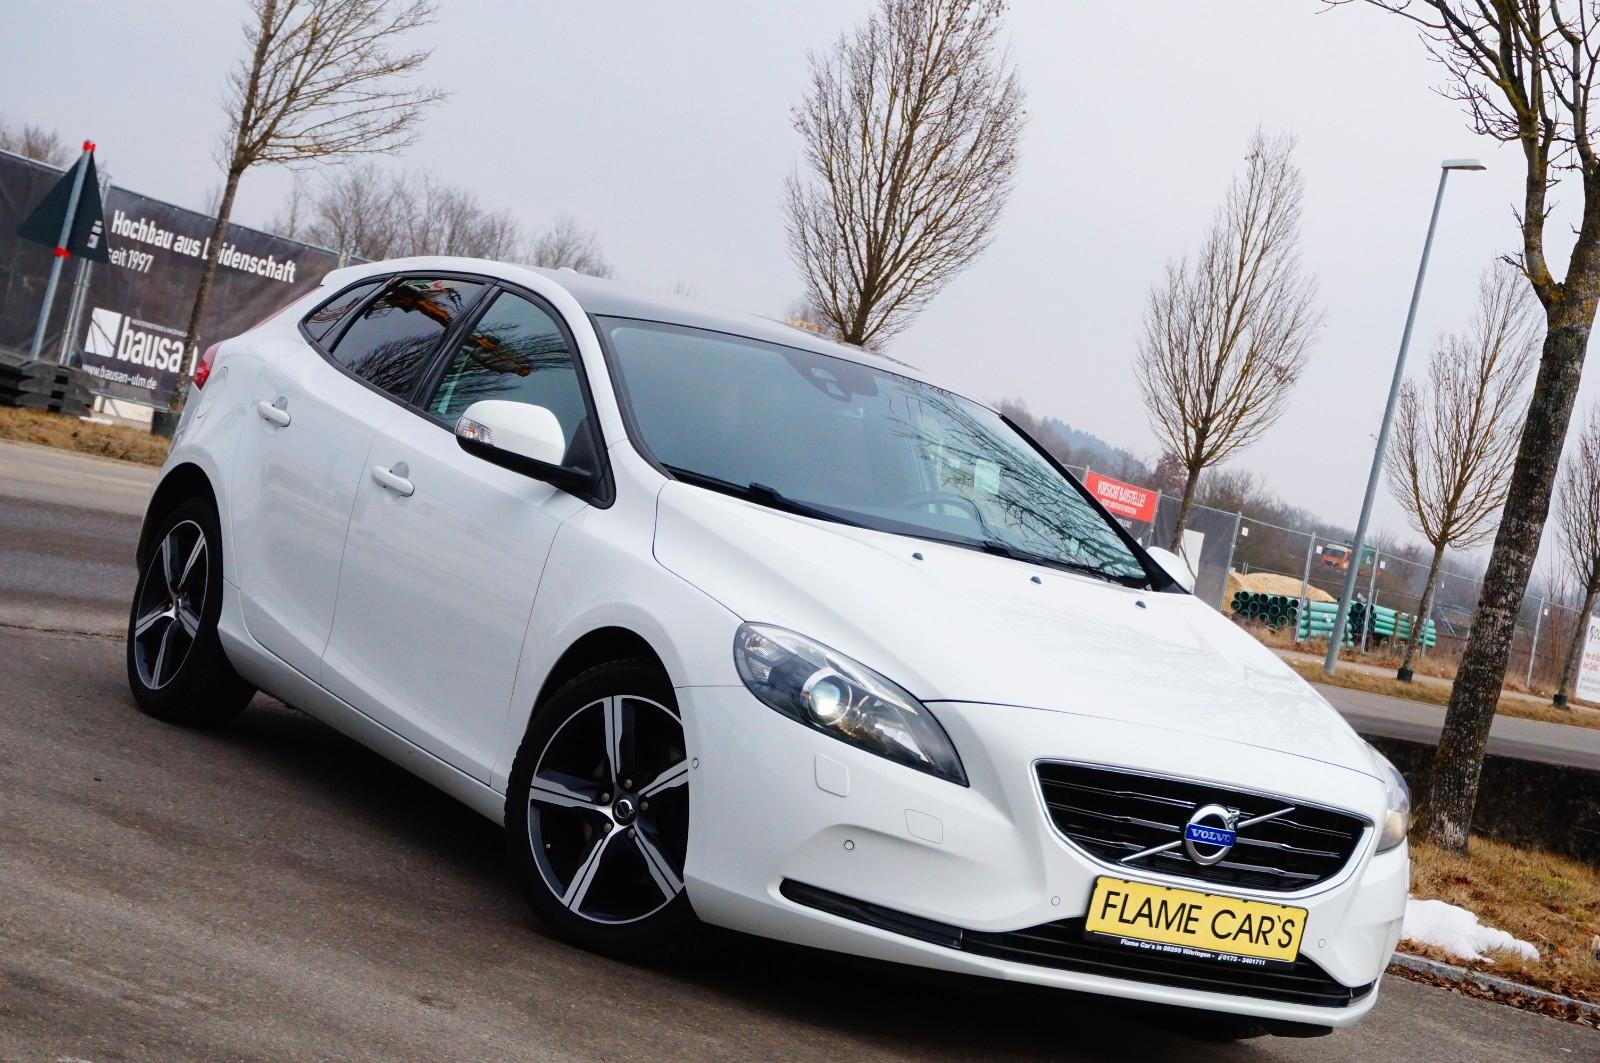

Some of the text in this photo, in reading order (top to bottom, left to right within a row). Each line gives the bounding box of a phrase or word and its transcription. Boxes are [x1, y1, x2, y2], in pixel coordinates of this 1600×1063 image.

[111, 209, 297, 284] Hochbau aus Lidenschaft
[127, 249, 154, 274] 1997
[81, 363, 158, 390] www.bausan-ulm.de
[1100, 890, 1203, 935] FLAME
[1120, 938, 1139, 947] Flame
